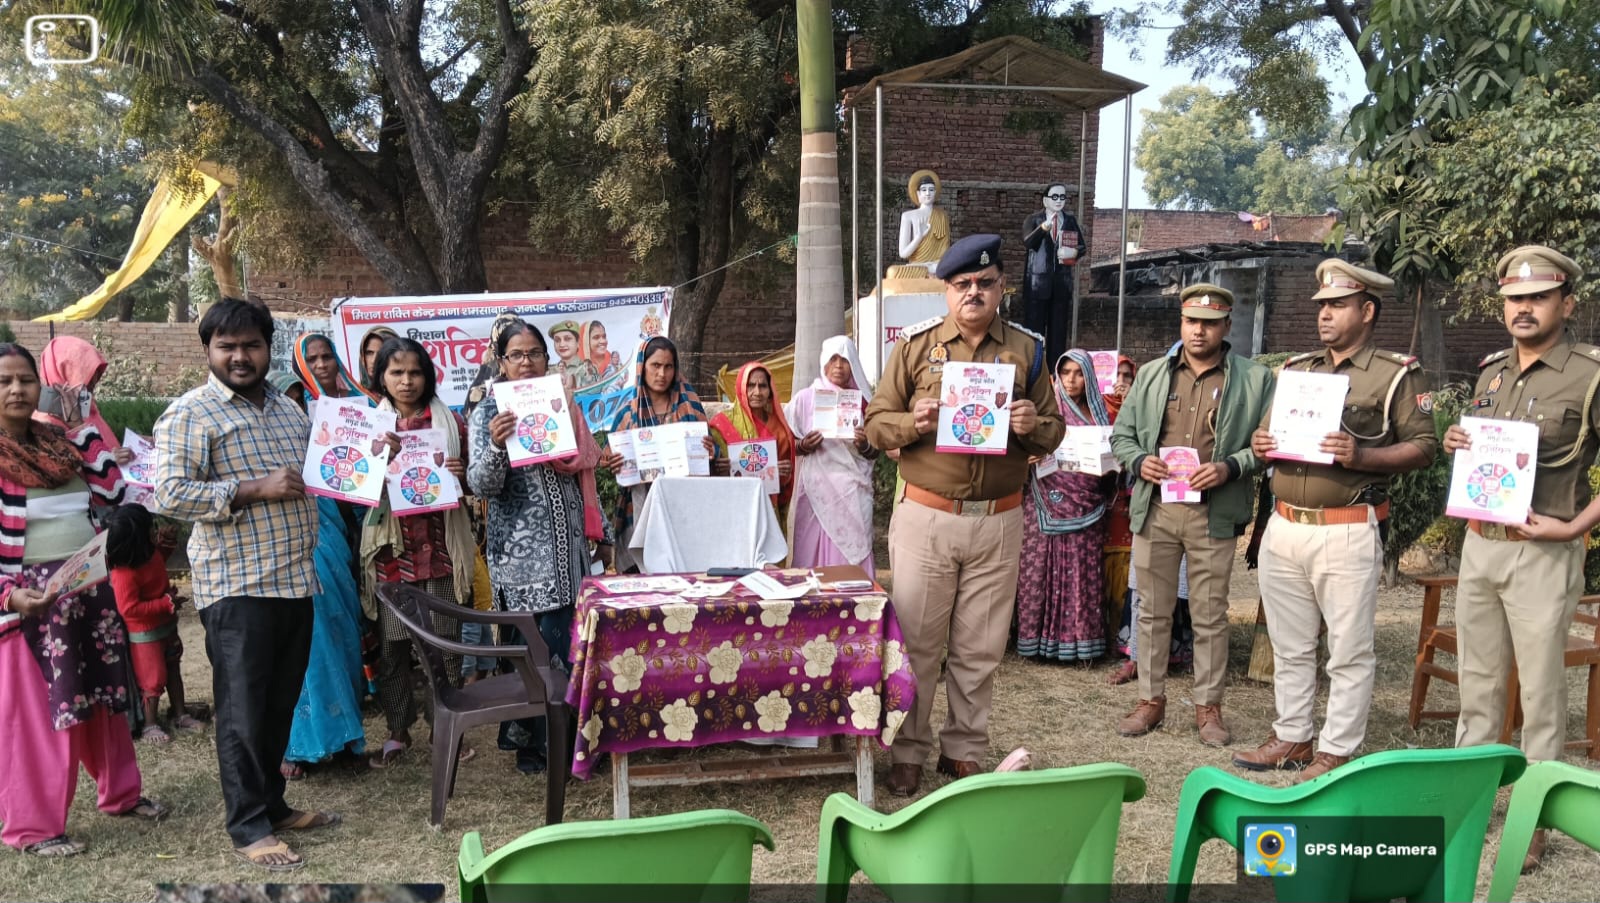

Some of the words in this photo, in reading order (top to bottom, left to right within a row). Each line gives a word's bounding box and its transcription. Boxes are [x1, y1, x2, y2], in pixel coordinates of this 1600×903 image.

[351, 308, 381, 321] मिशन
[383, 307, 410, 320] शक्ति
[407, 328, 446, 341] मिशन
